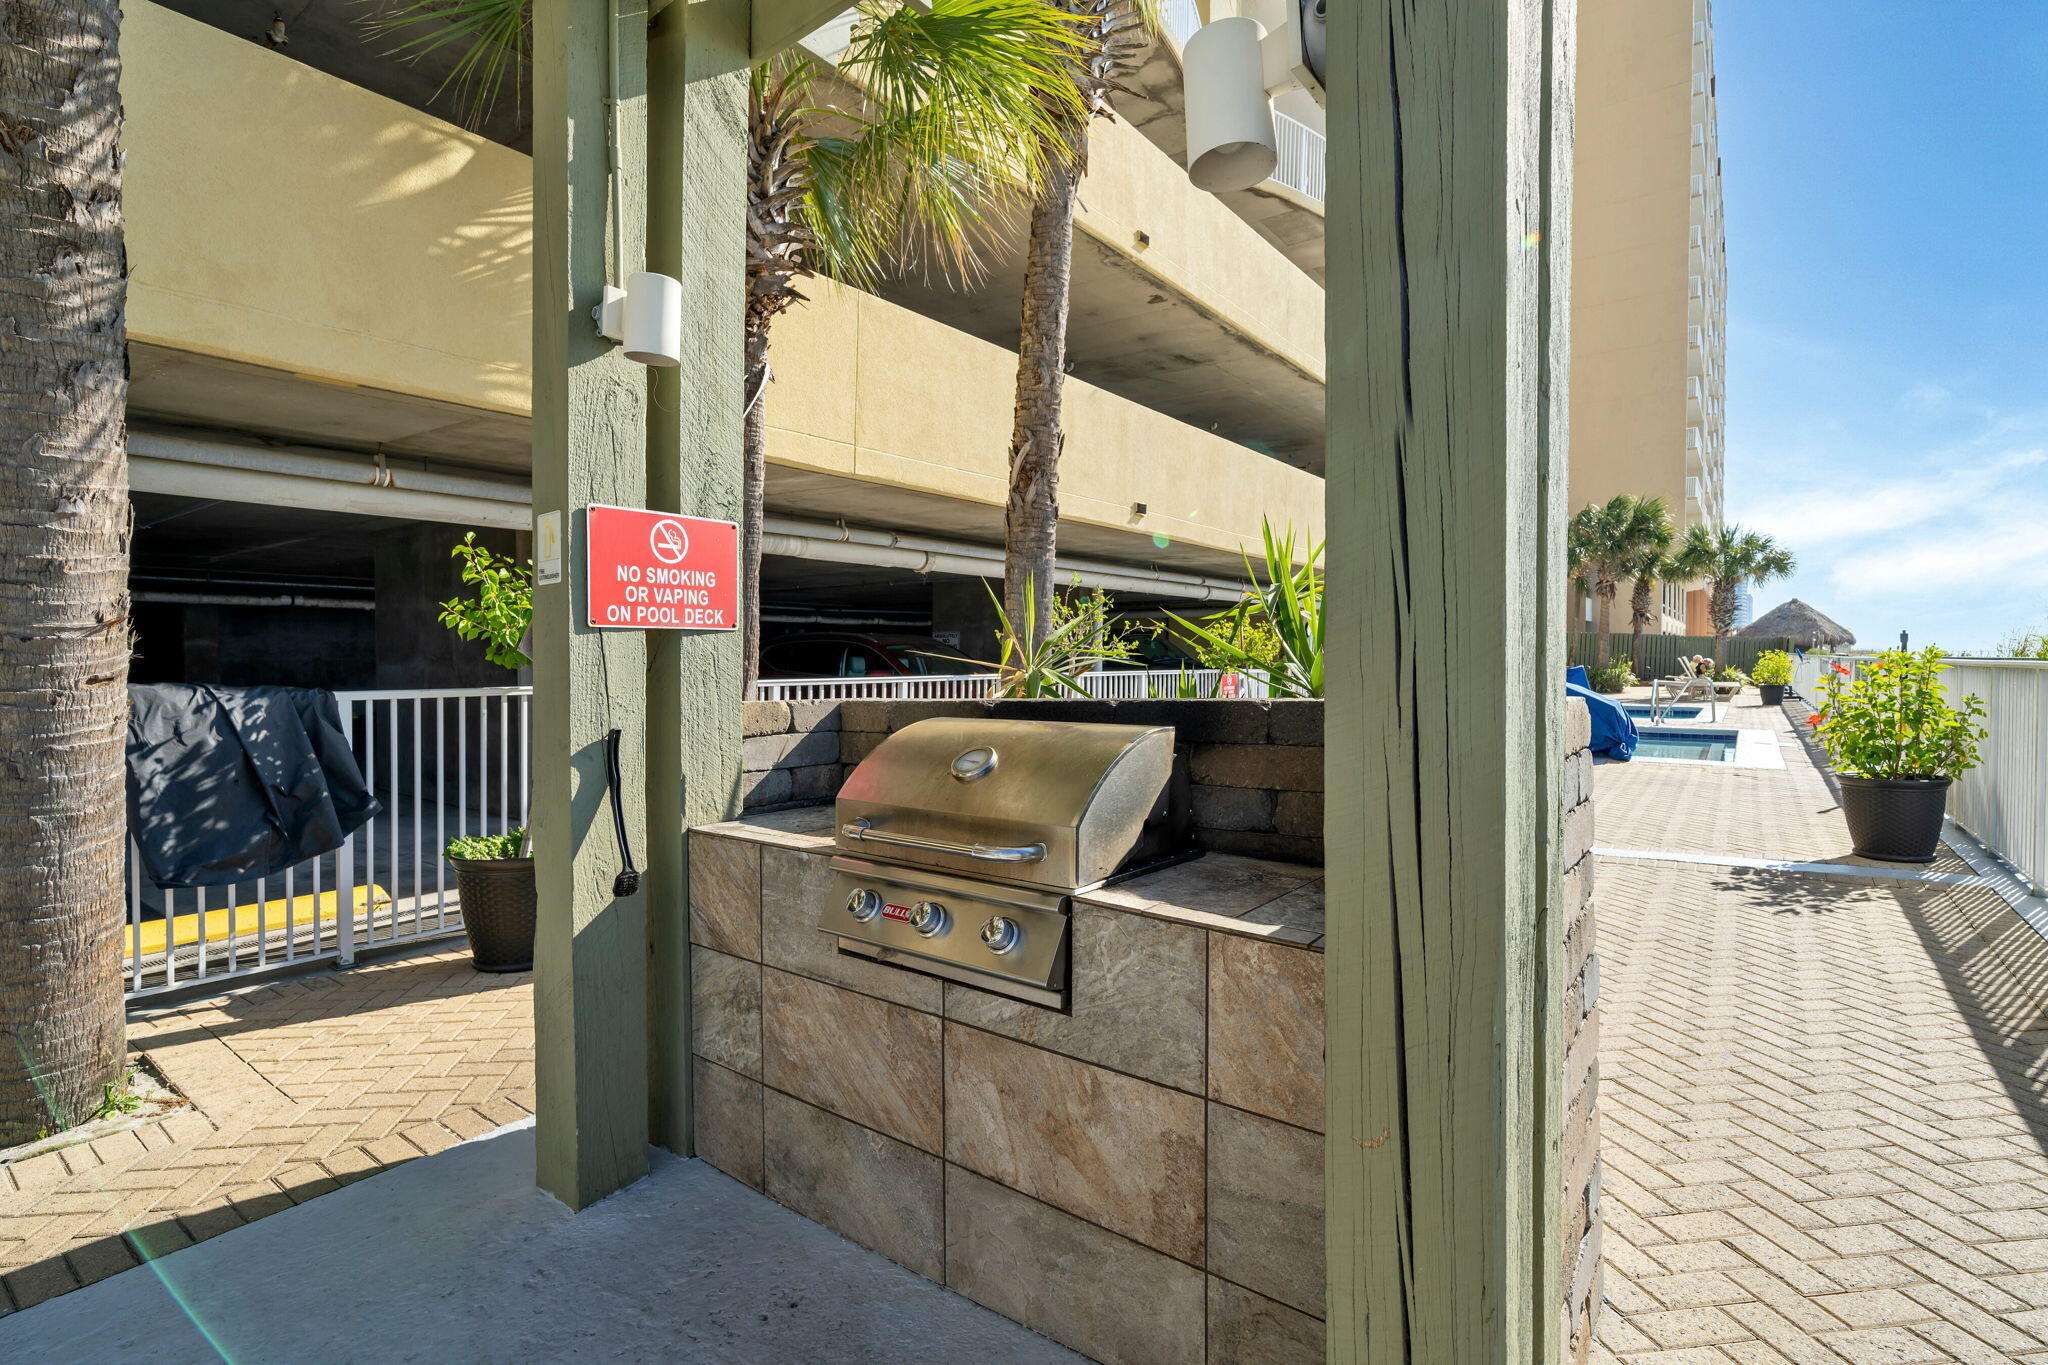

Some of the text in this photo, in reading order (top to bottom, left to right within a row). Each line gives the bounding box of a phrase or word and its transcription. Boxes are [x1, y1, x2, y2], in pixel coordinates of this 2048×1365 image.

[617, 565, 716, 587] NO SMOKING
[625, 585, 709, 605] OR VAPING
[606, 605, 724, 625] ON POOL DECK
